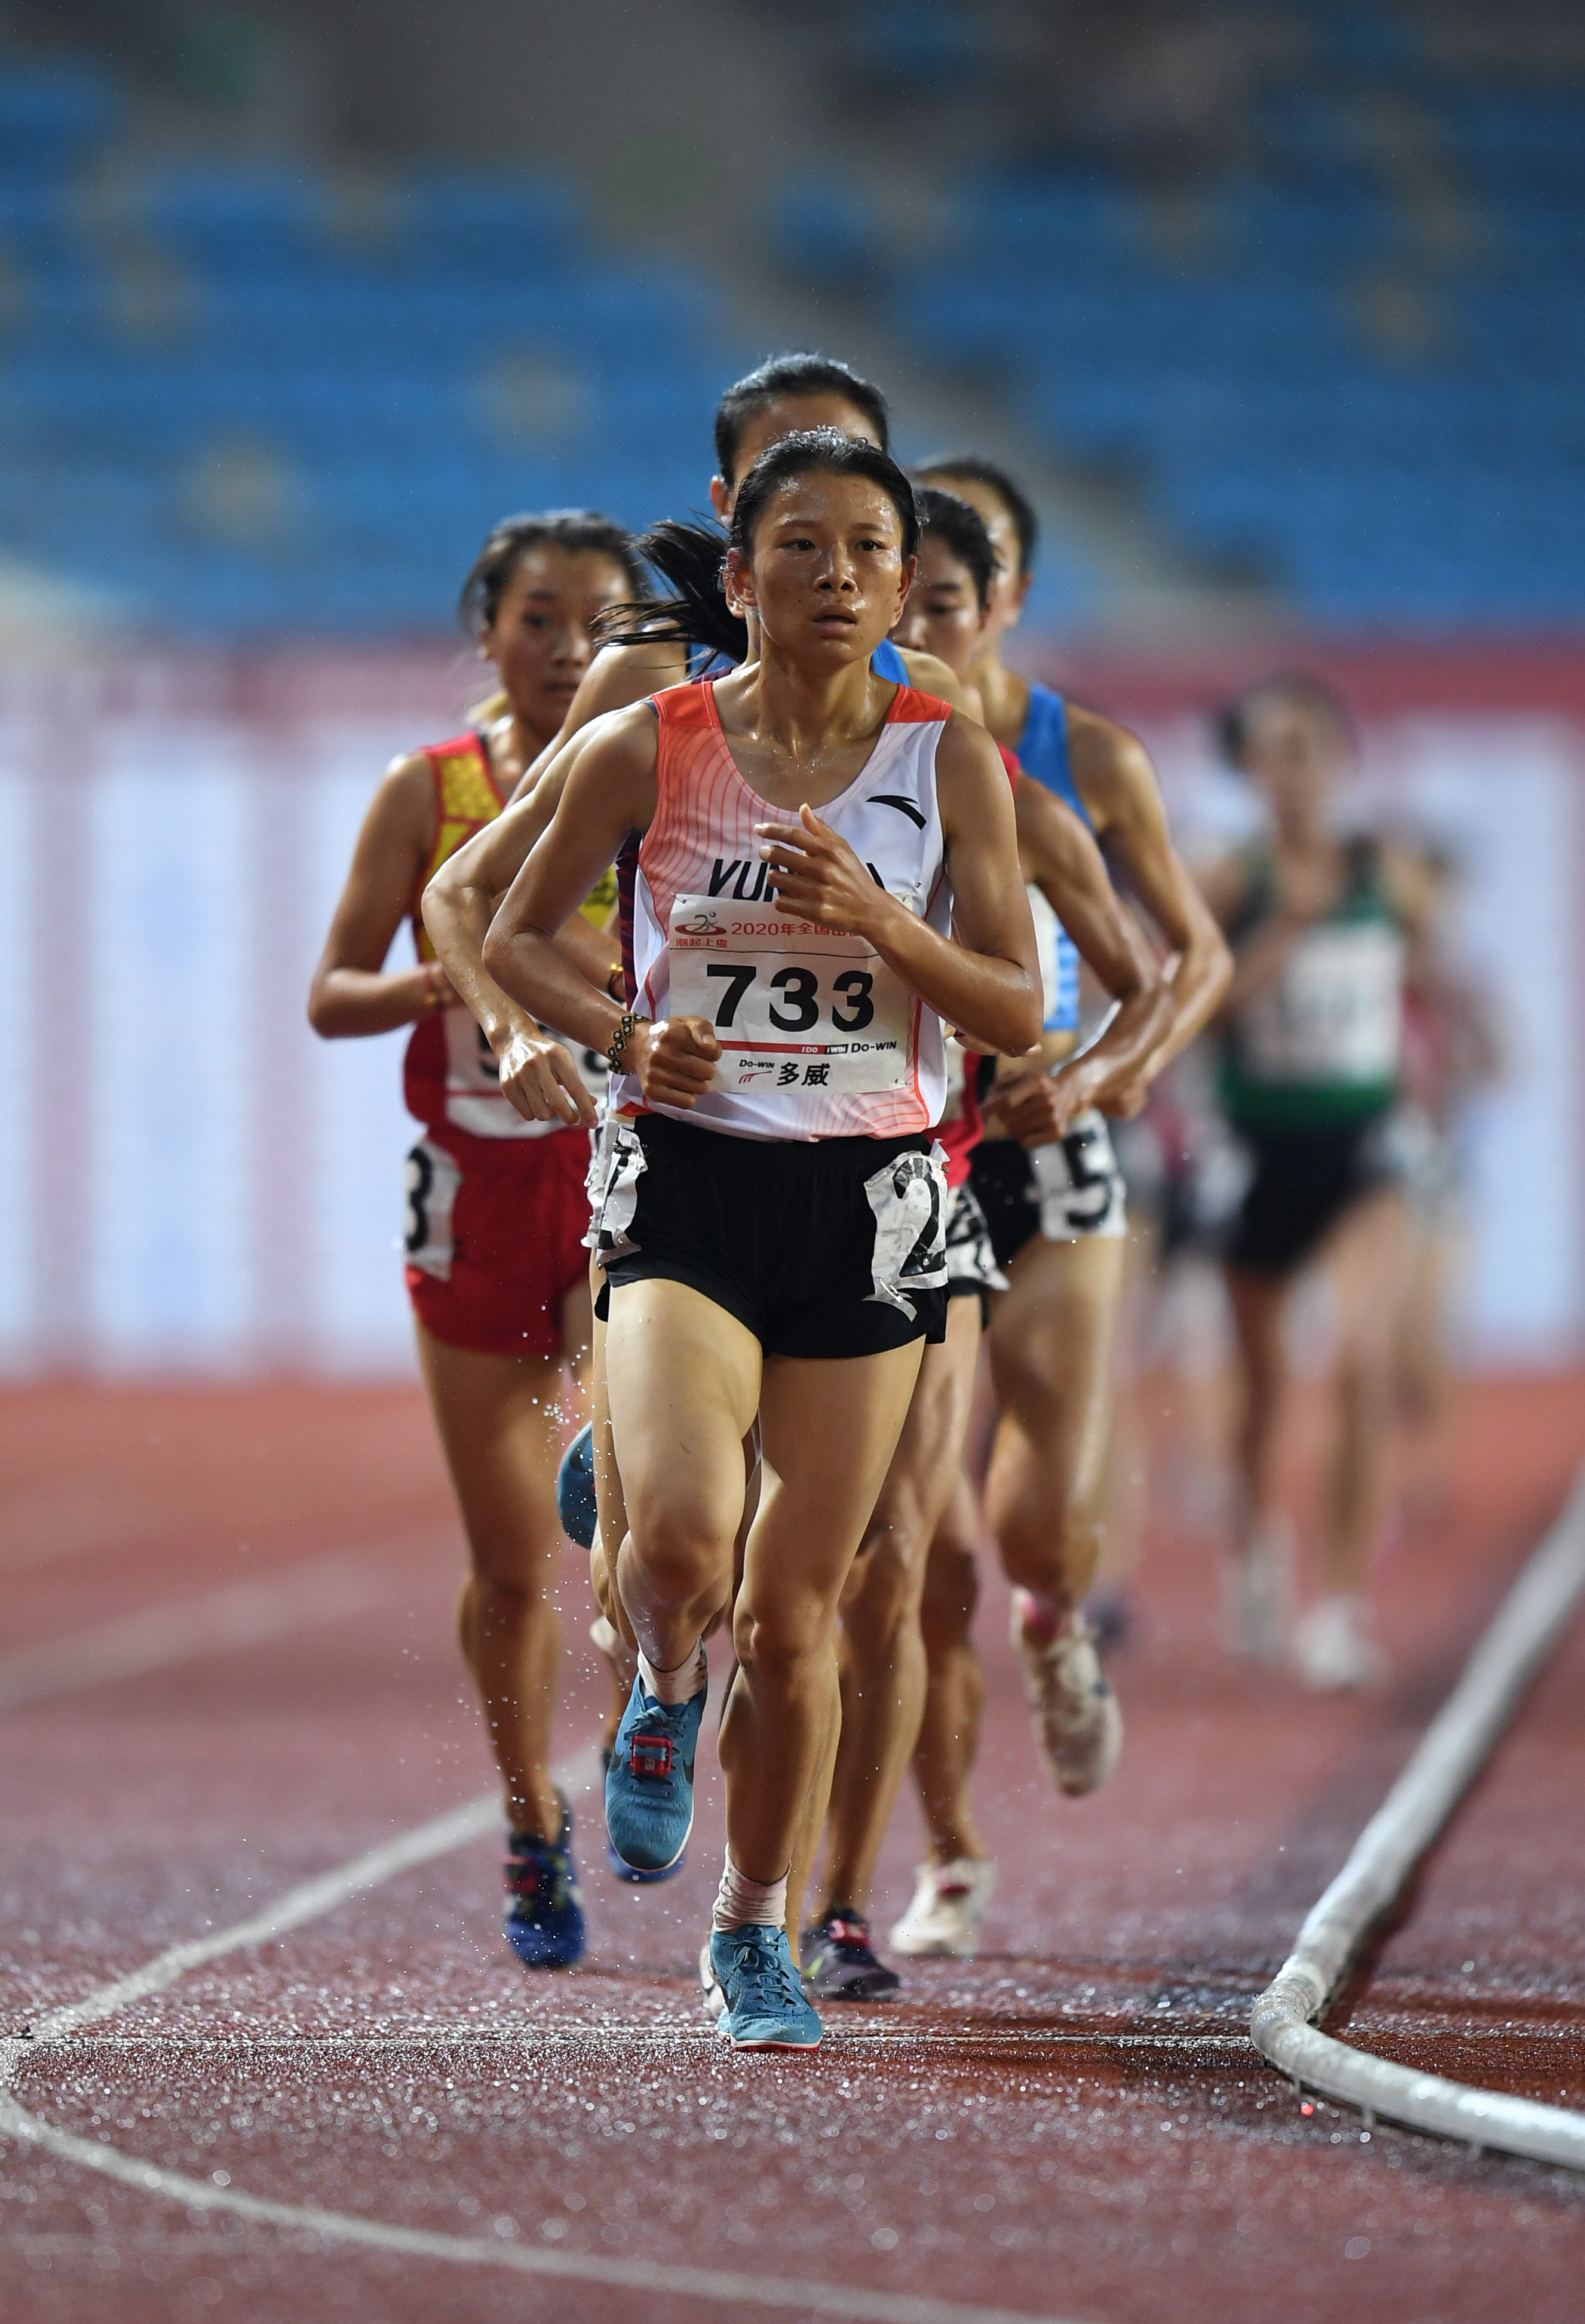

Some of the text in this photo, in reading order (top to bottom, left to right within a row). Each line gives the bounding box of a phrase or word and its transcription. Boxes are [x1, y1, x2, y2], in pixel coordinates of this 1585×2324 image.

[731, 922, 861, 937] 2020年全国
[707, 964, 874, 1033] 733
[777, 1062, 830, 1086] 多威
[1061, 1130, 1113, 1231] 5
[893, 1157, 946, 1277] 2
